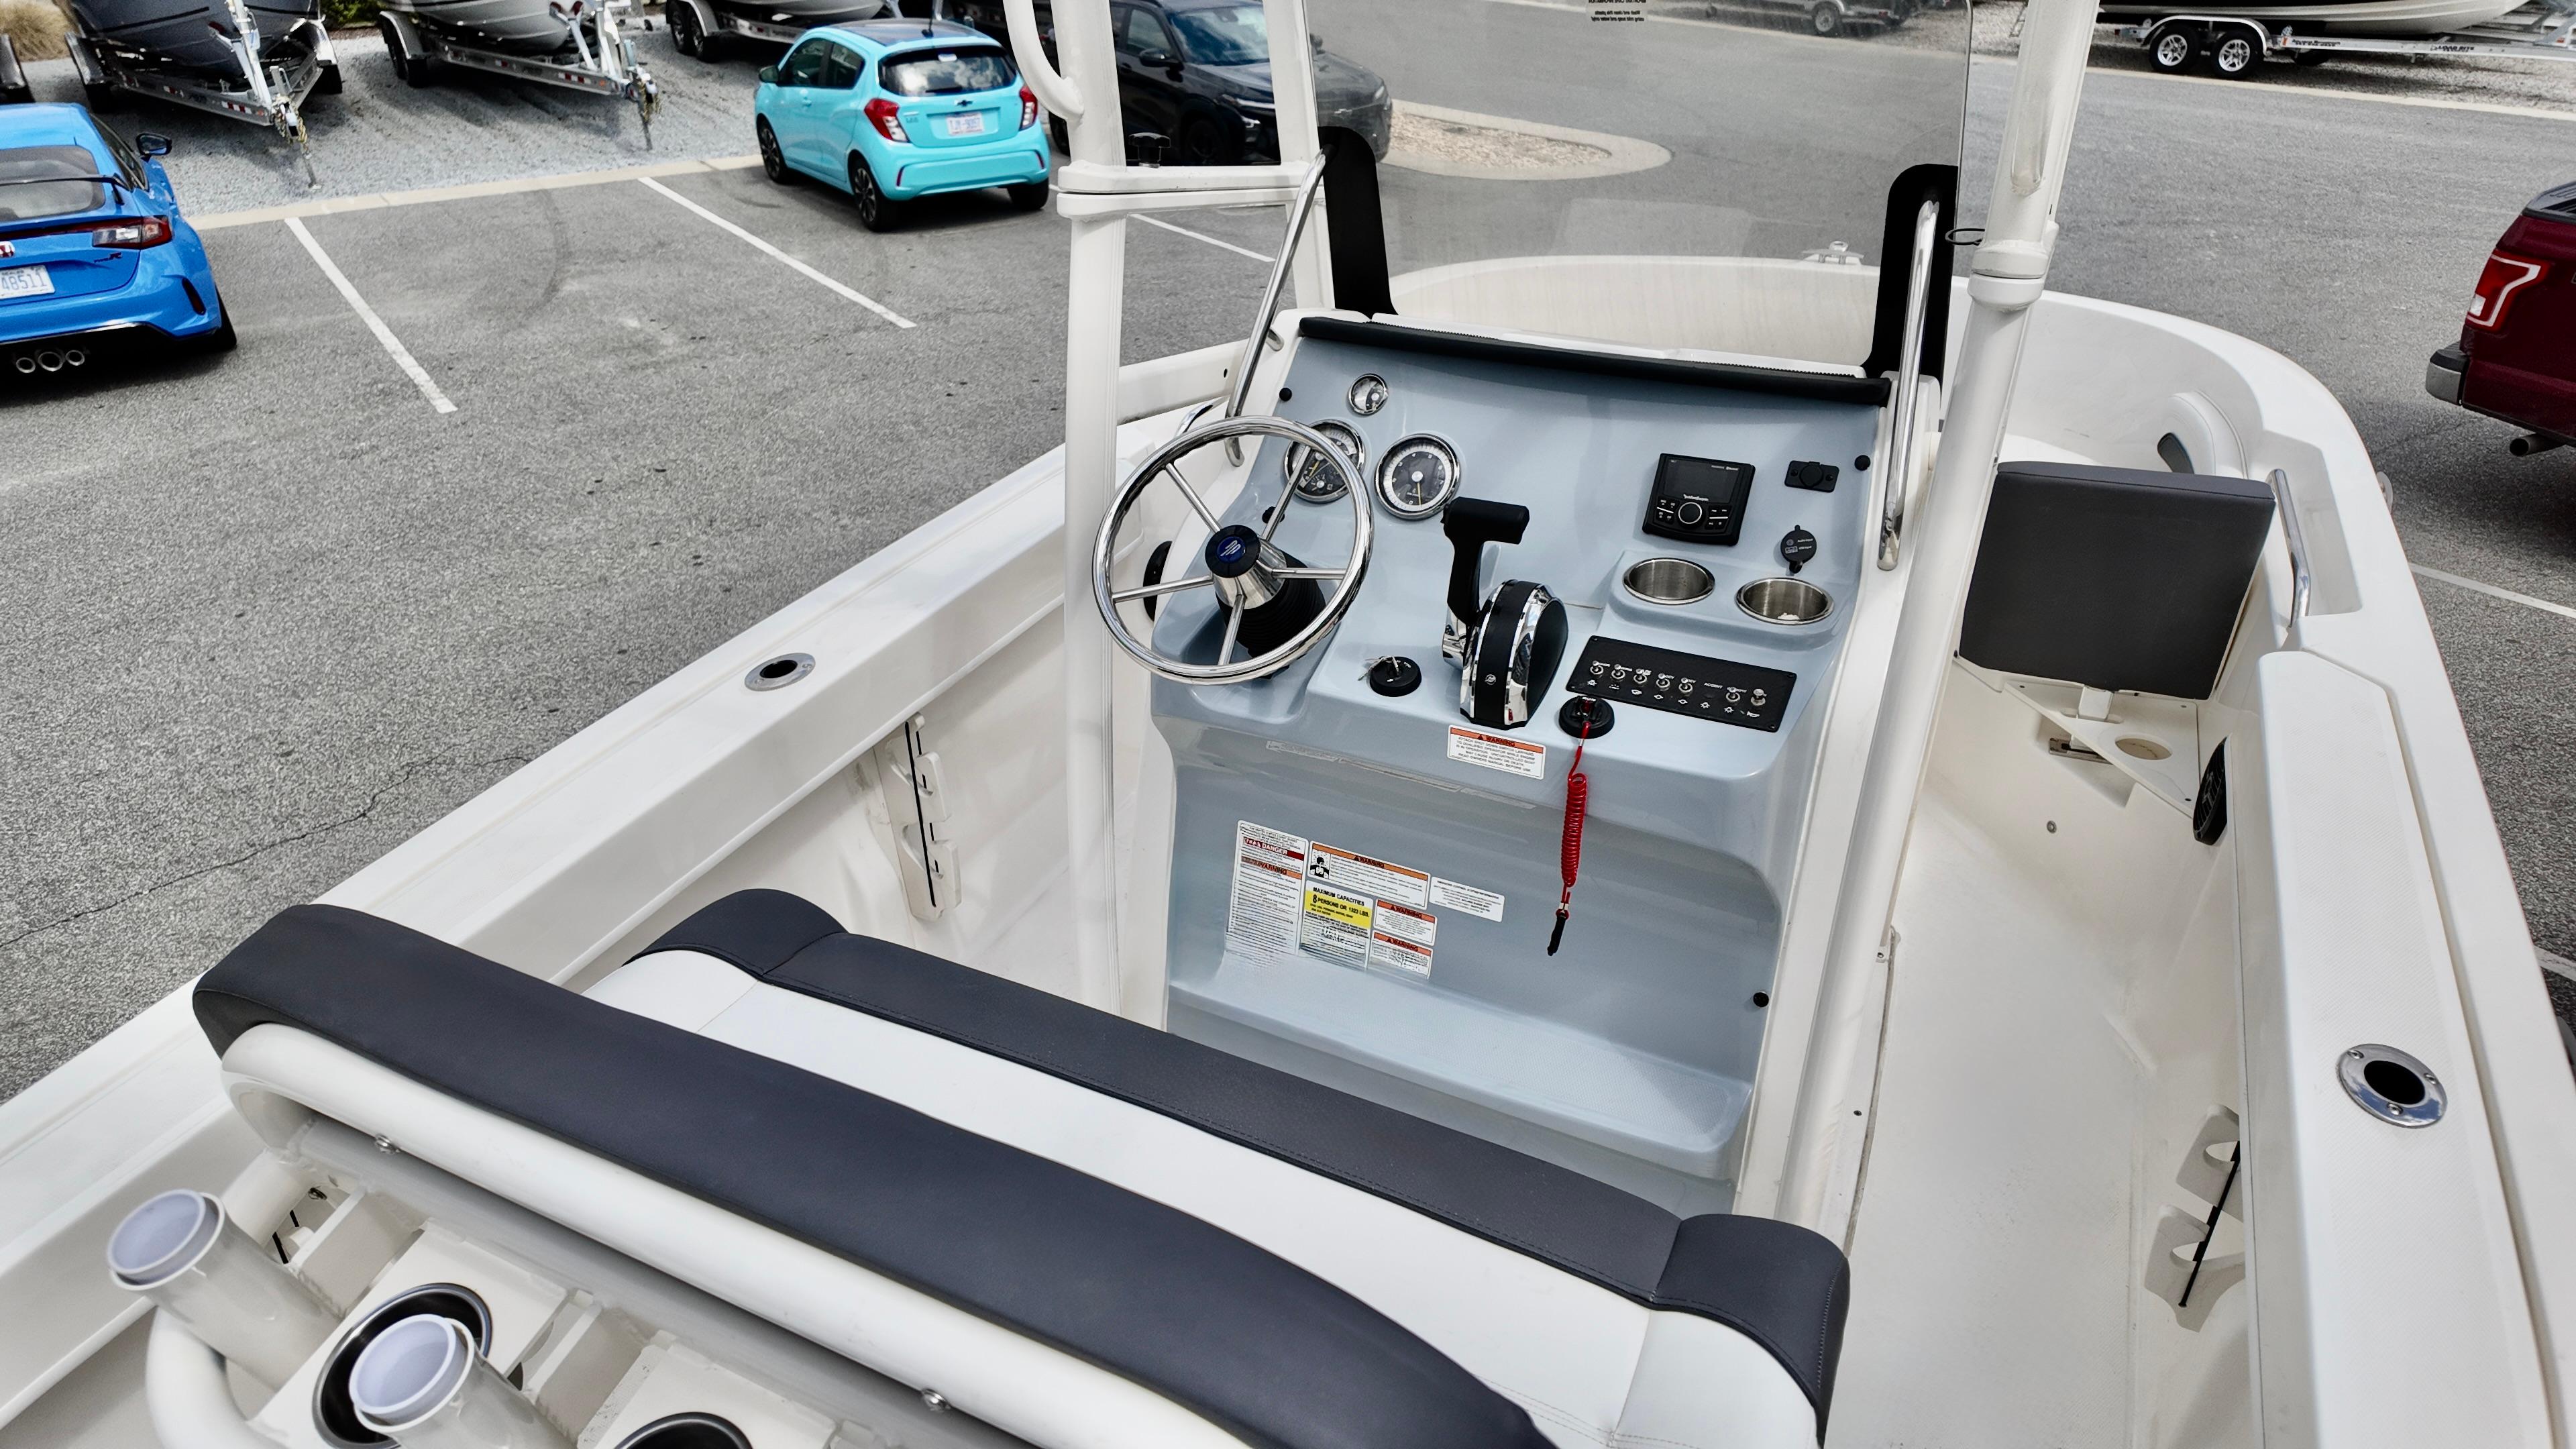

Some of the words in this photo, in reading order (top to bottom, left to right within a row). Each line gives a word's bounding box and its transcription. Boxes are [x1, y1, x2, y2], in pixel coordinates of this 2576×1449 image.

[1486, 735, 1515, 747] WARNING
[1262, 844, 1287, 855] DANGER
[1312, 894, 1318, 903] 8
[1318, 897, 1339, 908] PERSONS
[1313, 886, 1336, 898] MAXIMUM
[1336, 894, 1364, 906] CAPACITIES
